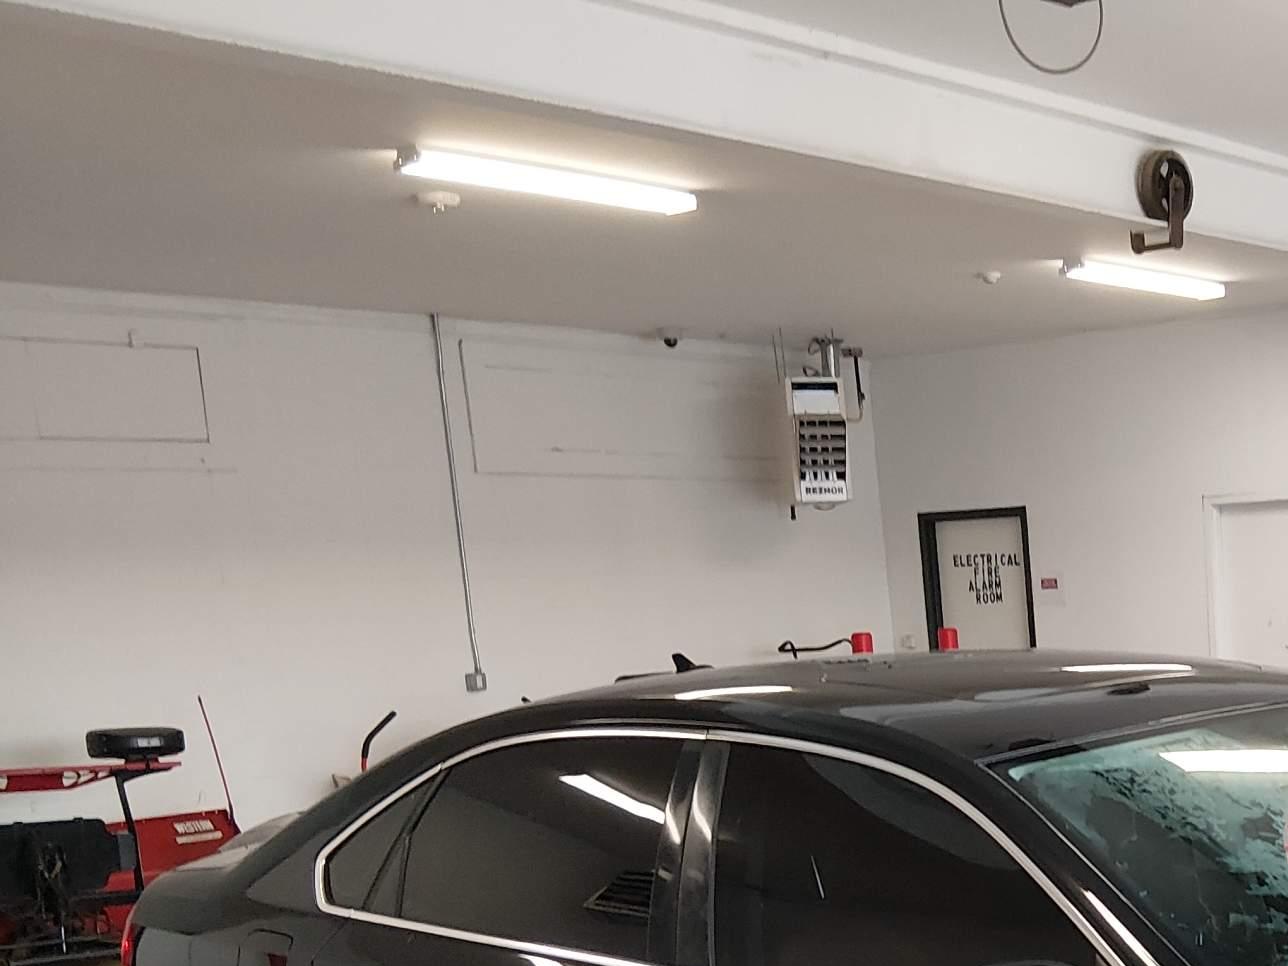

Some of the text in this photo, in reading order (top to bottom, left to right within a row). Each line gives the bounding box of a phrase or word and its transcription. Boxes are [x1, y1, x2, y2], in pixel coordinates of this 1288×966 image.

[952, 552, 1021, 568] ELECTRICAL
[974, 565, 1000, 579] FIRE
[968, 576, 1002, 592] ALARM
[975, 589, 1004, 605] ROOM
